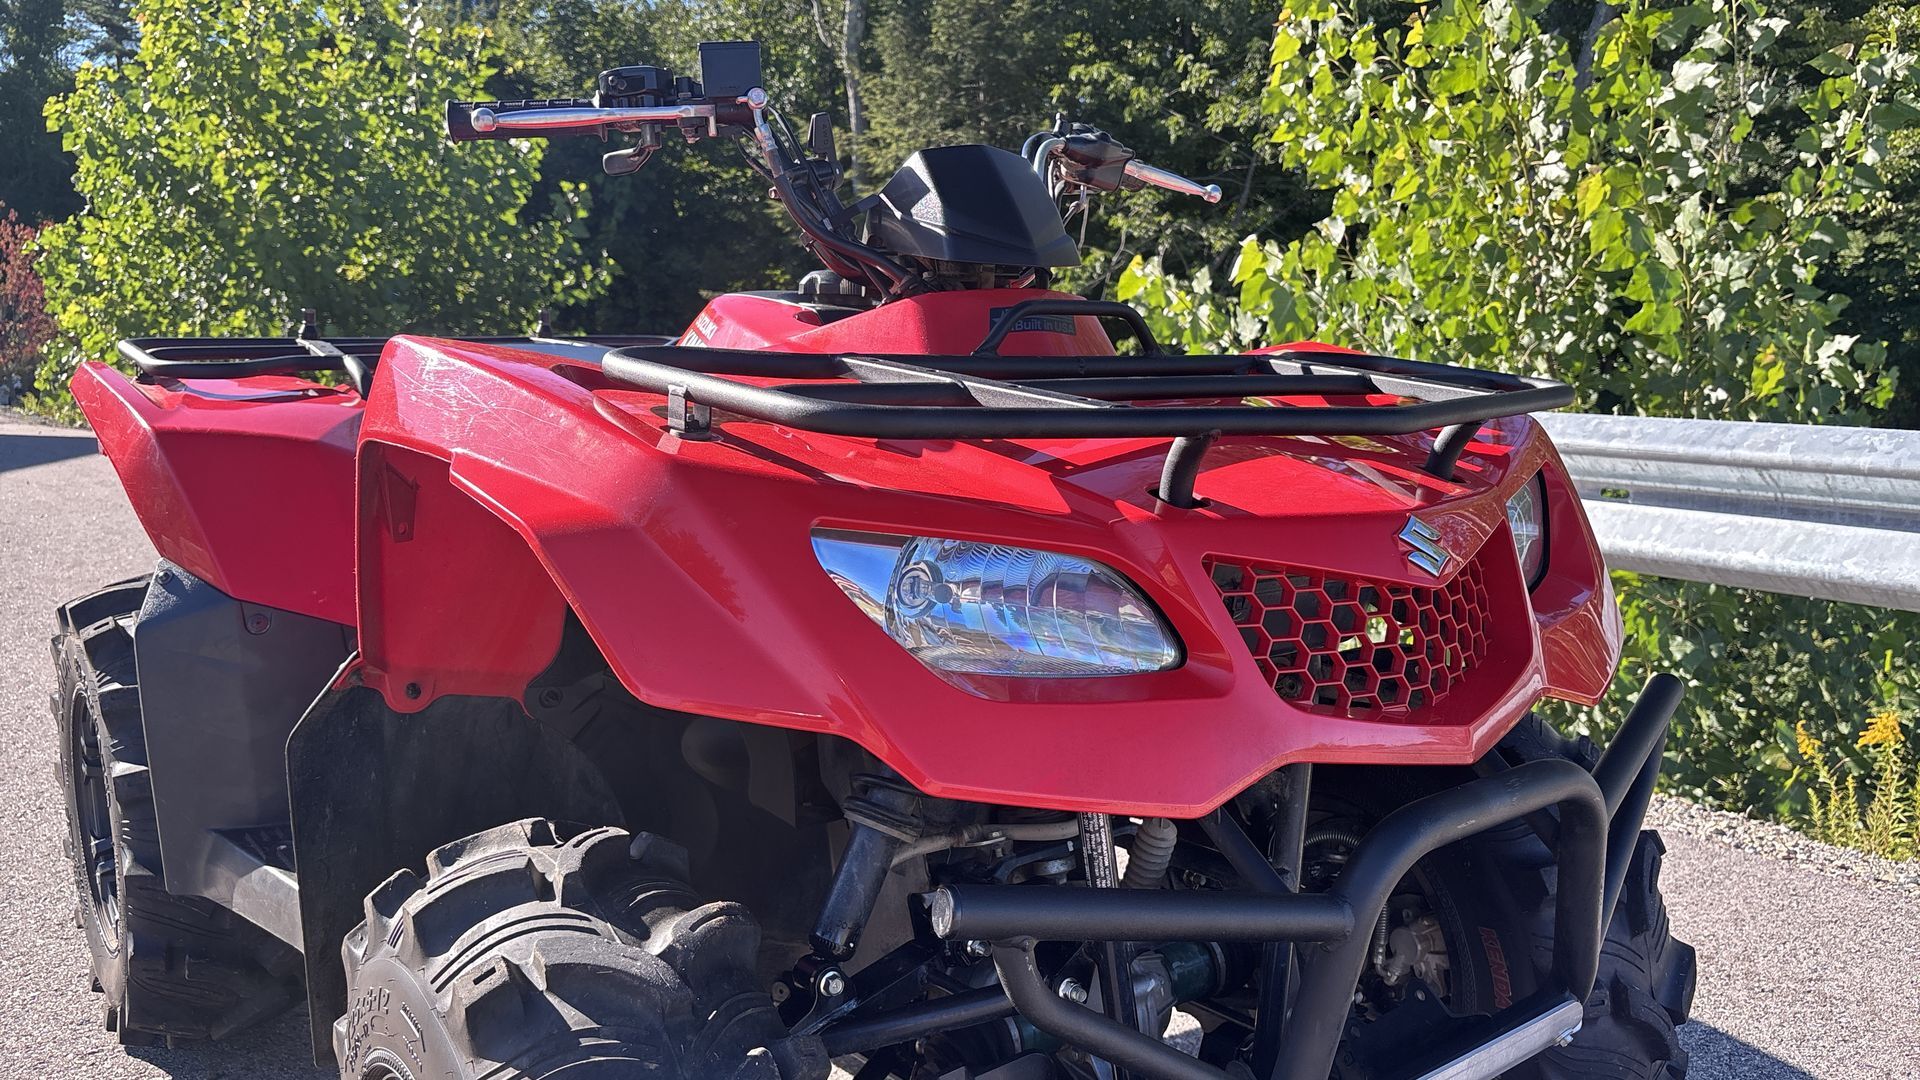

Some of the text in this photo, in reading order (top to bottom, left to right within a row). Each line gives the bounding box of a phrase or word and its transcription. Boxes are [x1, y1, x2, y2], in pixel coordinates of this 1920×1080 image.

[1016, 319, 1041, 330] Built
[1055, 320, 1074, 333] USA
[1100, 828, 1109, 866] CORPORATION
